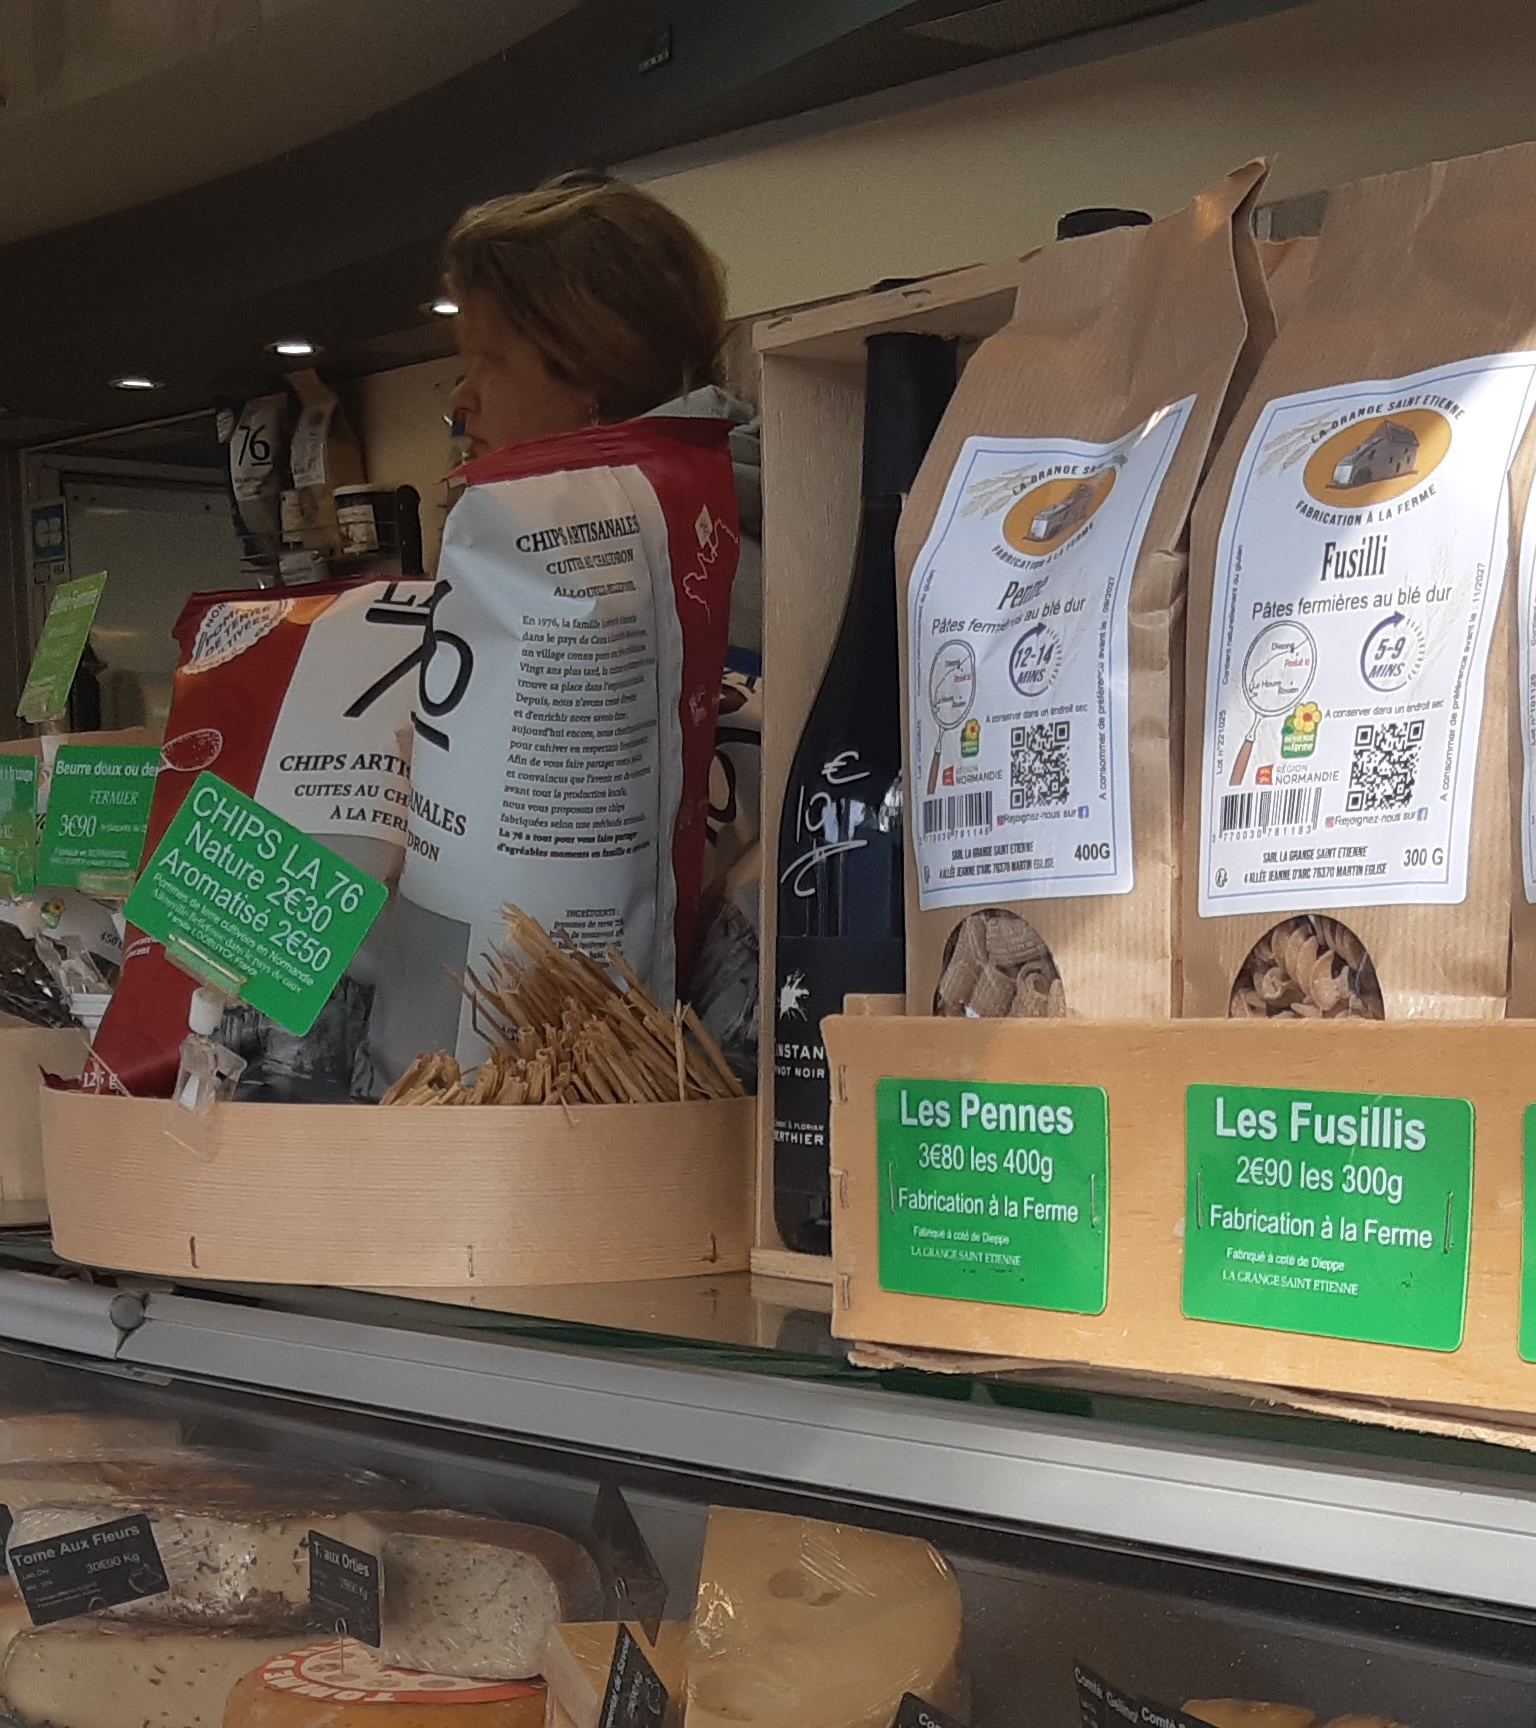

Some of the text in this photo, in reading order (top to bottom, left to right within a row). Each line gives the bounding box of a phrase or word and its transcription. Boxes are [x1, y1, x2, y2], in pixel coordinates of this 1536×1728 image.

[1320, 535, 1388, 581] Fusilli
[192, 787, 364, 913] CHIPS LA 76
[184, 821, 333, 933] Nature 2€30
[158, 848, 331, 972] Aromatisé 2€50
[900, 1090, 1074, 1135] Les Pennes
[1216, 1097, 1426, 1151] Les Fusillis
[919, 1143, 1053, 1183] 3€80 les 400g
[1236, 1156, 1403, 1204] 2€90 les 300g
[1210, 1204, 1433, 1249] Fabrication à la Ferme
[12, 1523, 141, 1569] Tome Aux Fleurs
